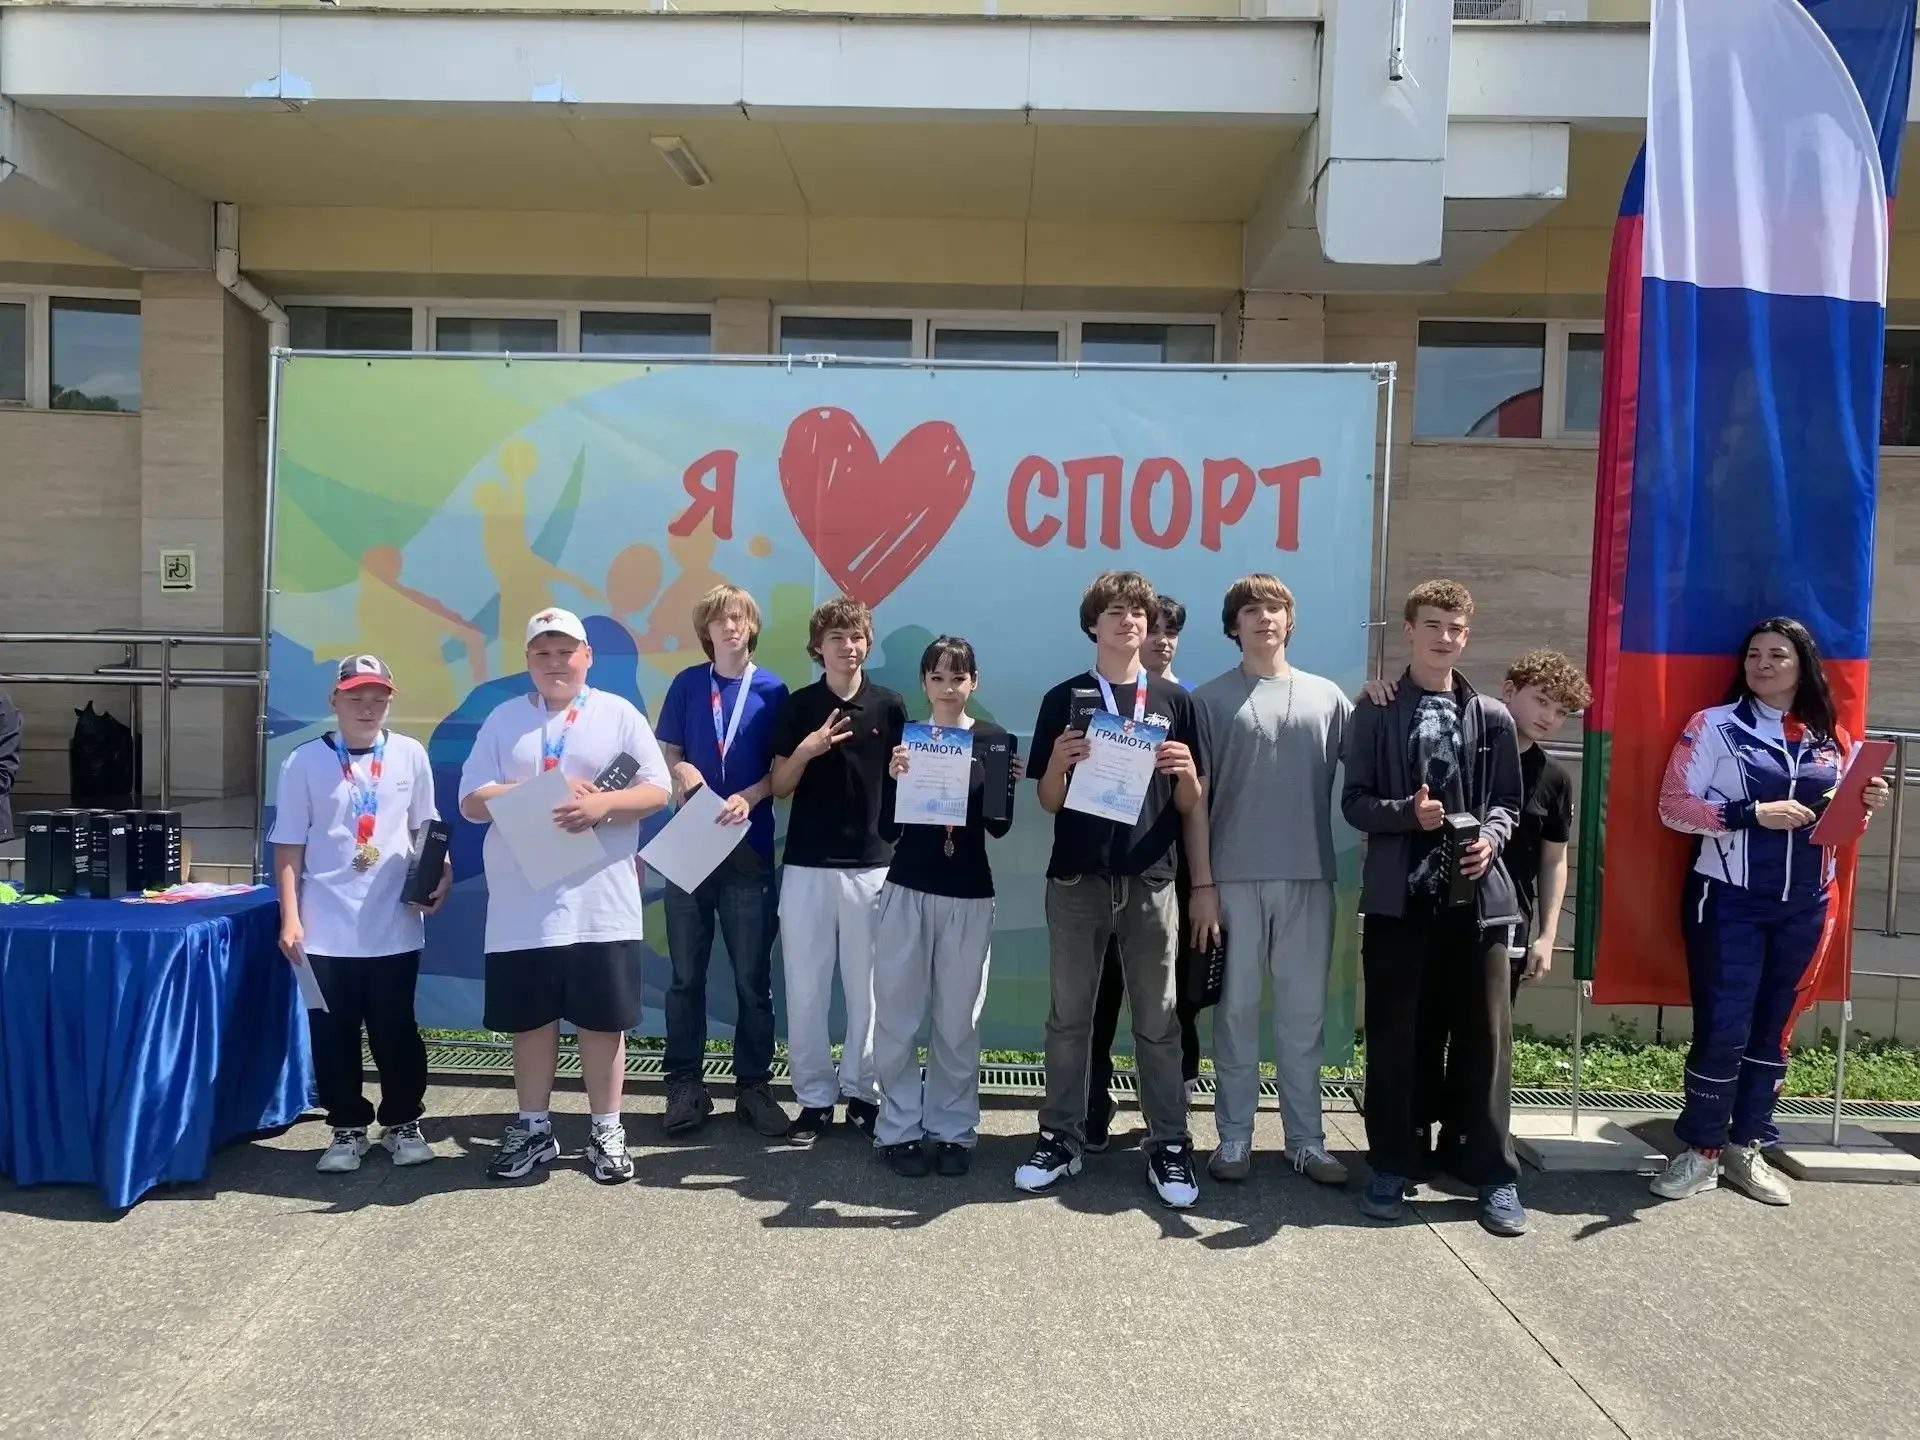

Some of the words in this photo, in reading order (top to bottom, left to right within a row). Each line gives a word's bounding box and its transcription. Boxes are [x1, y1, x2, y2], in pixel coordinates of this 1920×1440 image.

[668, 449, 738, 539] Я
[1007, 454, 1321, 552] СПОРТ
[908, 741, 963, 755] ГРАМОТА
[1095, 728, 1152, 752] ГРАМОТА
